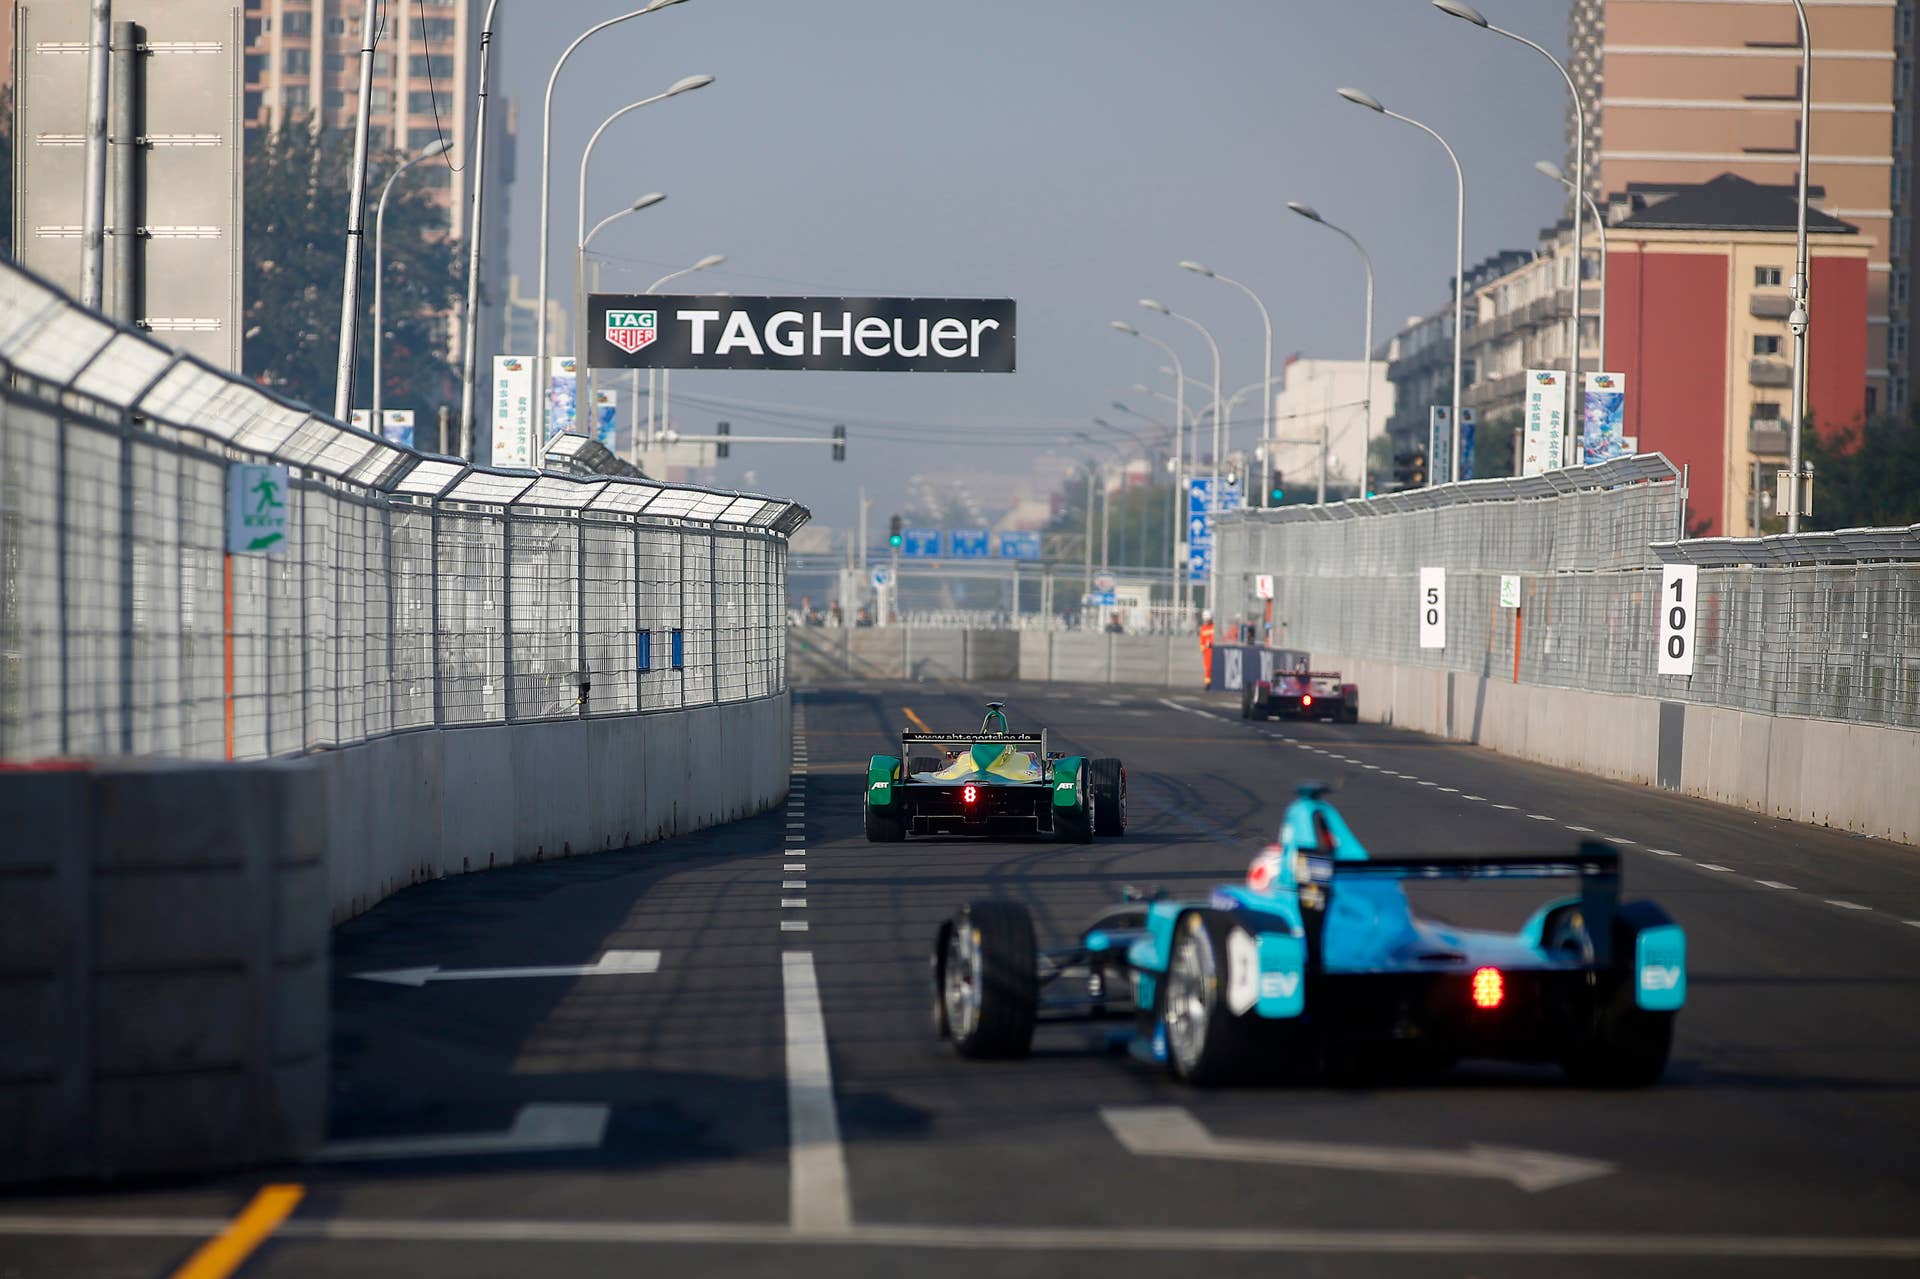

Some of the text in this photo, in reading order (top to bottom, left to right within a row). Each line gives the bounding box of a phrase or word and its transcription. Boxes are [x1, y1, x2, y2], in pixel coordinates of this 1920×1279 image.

[610, 313, 653, 327] TAG
[609, 329, 654, 349] HEUER
[1426, 588, 1438, 626] 50
[1667, 578, 1687, 659] 100
[871, 781, 890, 790] ABT
[1056, 782, 1075, 791] ABT
[1261, 971, 1299, 998] EV
[1641, 965, 1681, 990] EV
